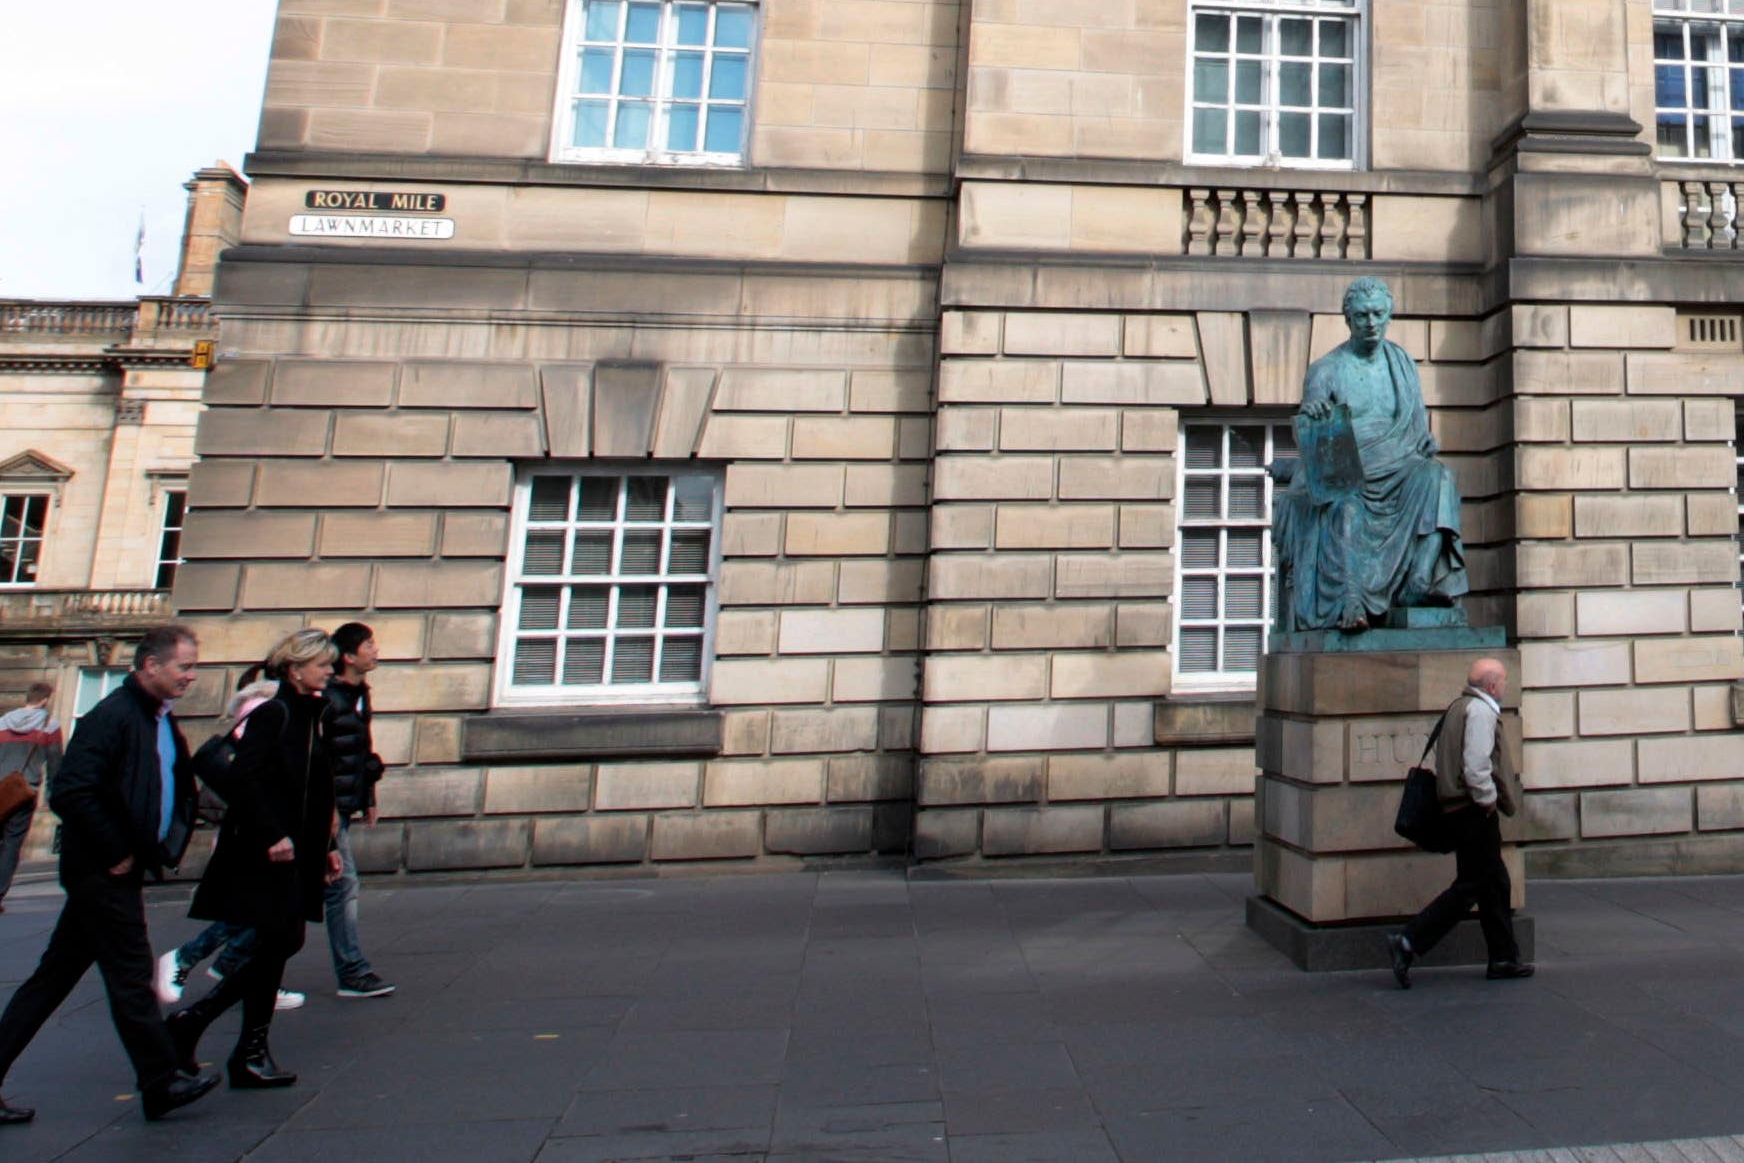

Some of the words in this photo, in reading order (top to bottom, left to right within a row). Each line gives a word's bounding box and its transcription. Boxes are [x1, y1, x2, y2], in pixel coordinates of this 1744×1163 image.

[314, 192, 379, 209] ROYAL
[391, 196, 437, 211] MILE
[301, 216, 443, 236] LAWNMARKET
